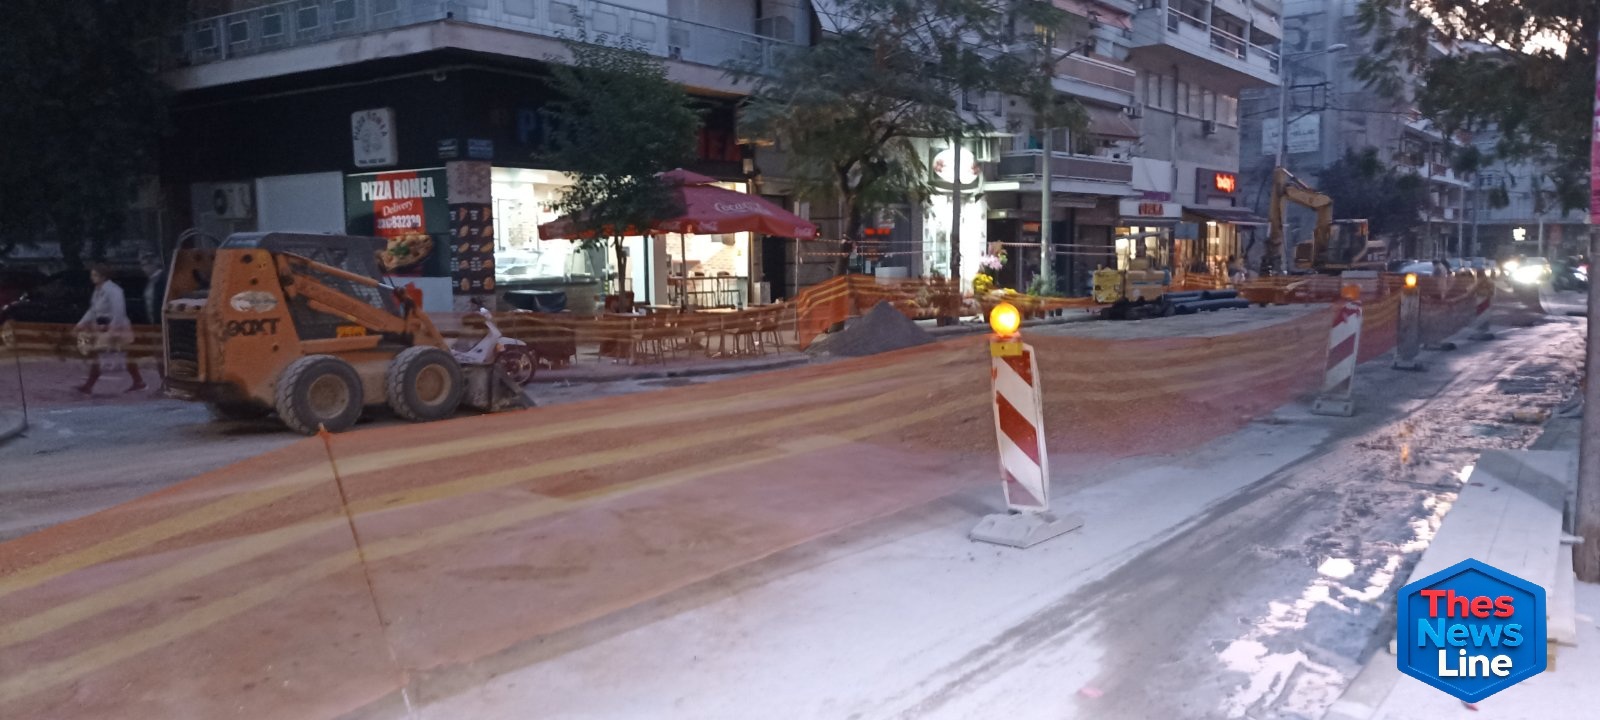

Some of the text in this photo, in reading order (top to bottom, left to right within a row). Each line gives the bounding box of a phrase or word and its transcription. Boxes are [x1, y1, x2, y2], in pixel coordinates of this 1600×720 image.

[361, 177, 435, 201] PIZZA ROMEA
[382, 200, 414, 216] Delivery
